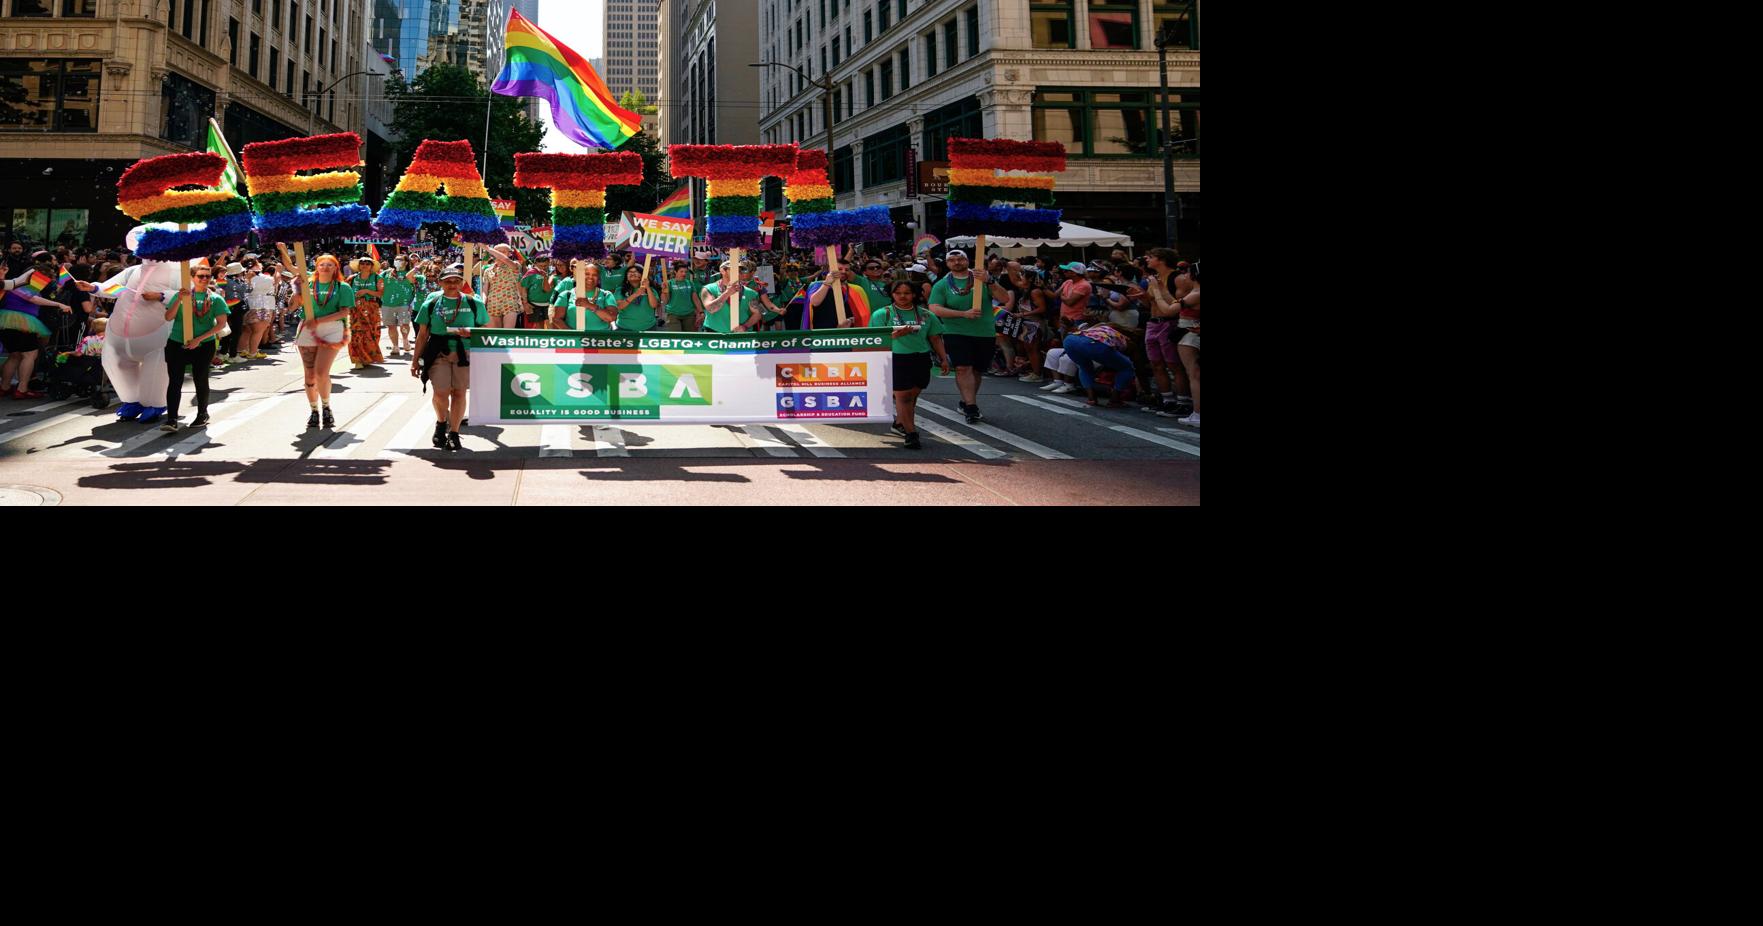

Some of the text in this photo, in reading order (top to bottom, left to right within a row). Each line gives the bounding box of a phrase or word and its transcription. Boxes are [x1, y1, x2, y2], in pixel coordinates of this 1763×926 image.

[491, 201, 511, 210] SAY
[633, 217, 658, 229] WE
[662, 220, 692, 232] SAY
[532, 230, 550, 238] WE
[629, 229, 688, 254] QUEER
[481, 335, 883, 349] Washington State's LGBTQ+ Chamber of Commerce
[781, 367, 863, 378] CHBA
[510, 372, 703, 398] GSBA
[780, 395, 863, 408] GSBA
